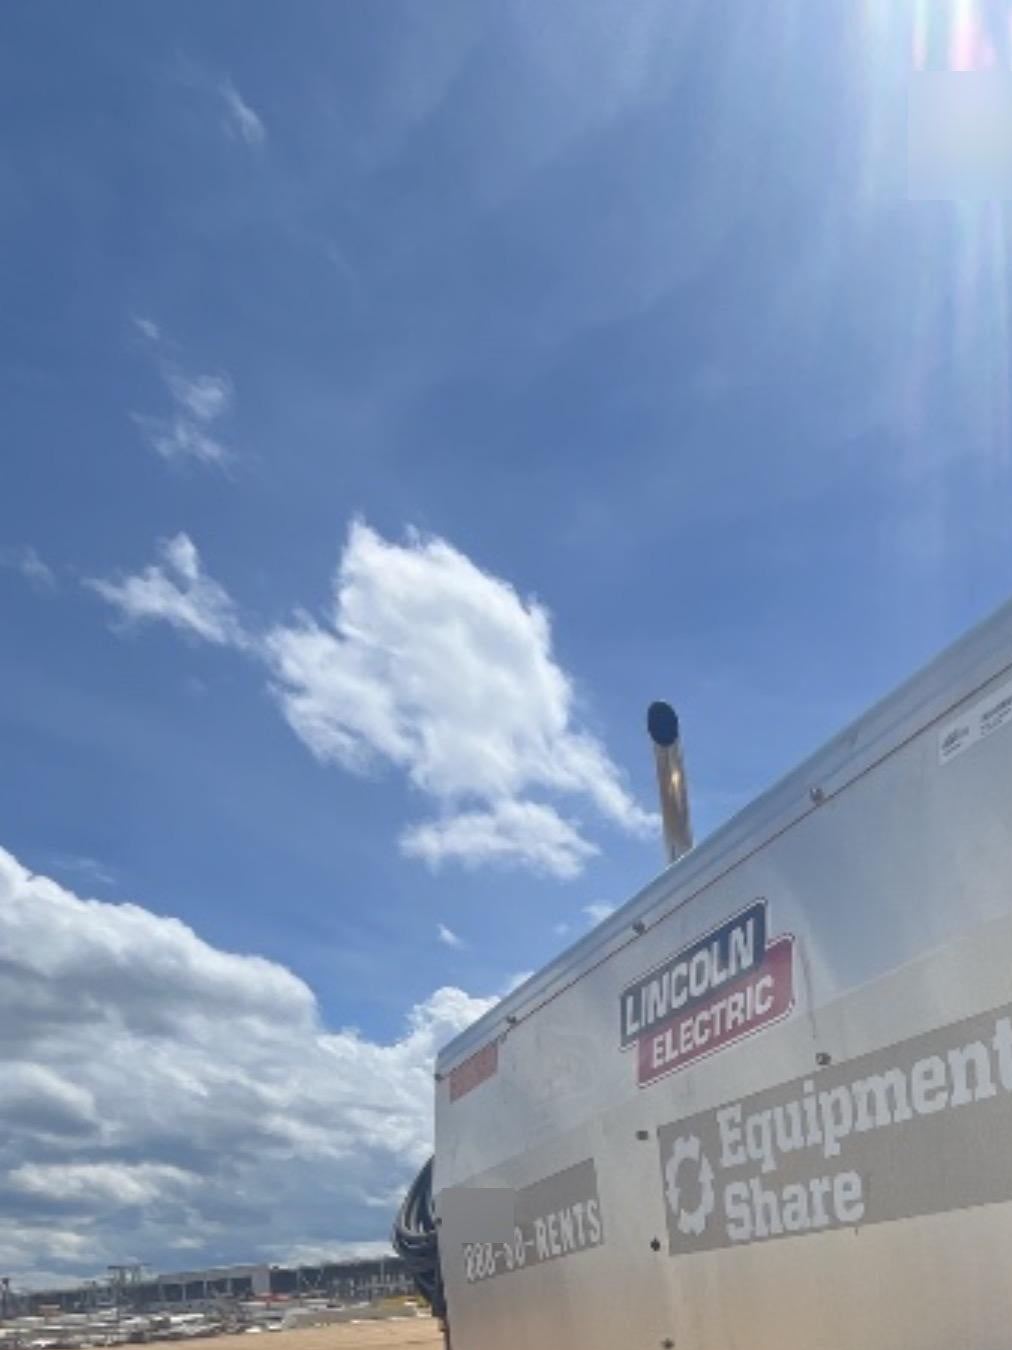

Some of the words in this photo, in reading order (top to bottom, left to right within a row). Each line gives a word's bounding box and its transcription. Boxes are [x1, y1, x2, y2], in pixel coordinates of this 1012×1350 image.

[625, 917, 755, 1036] LINCOLN
[652, 974, 775, 1069] ELECTRIC
[723, 1169, 866, 1242] Share
